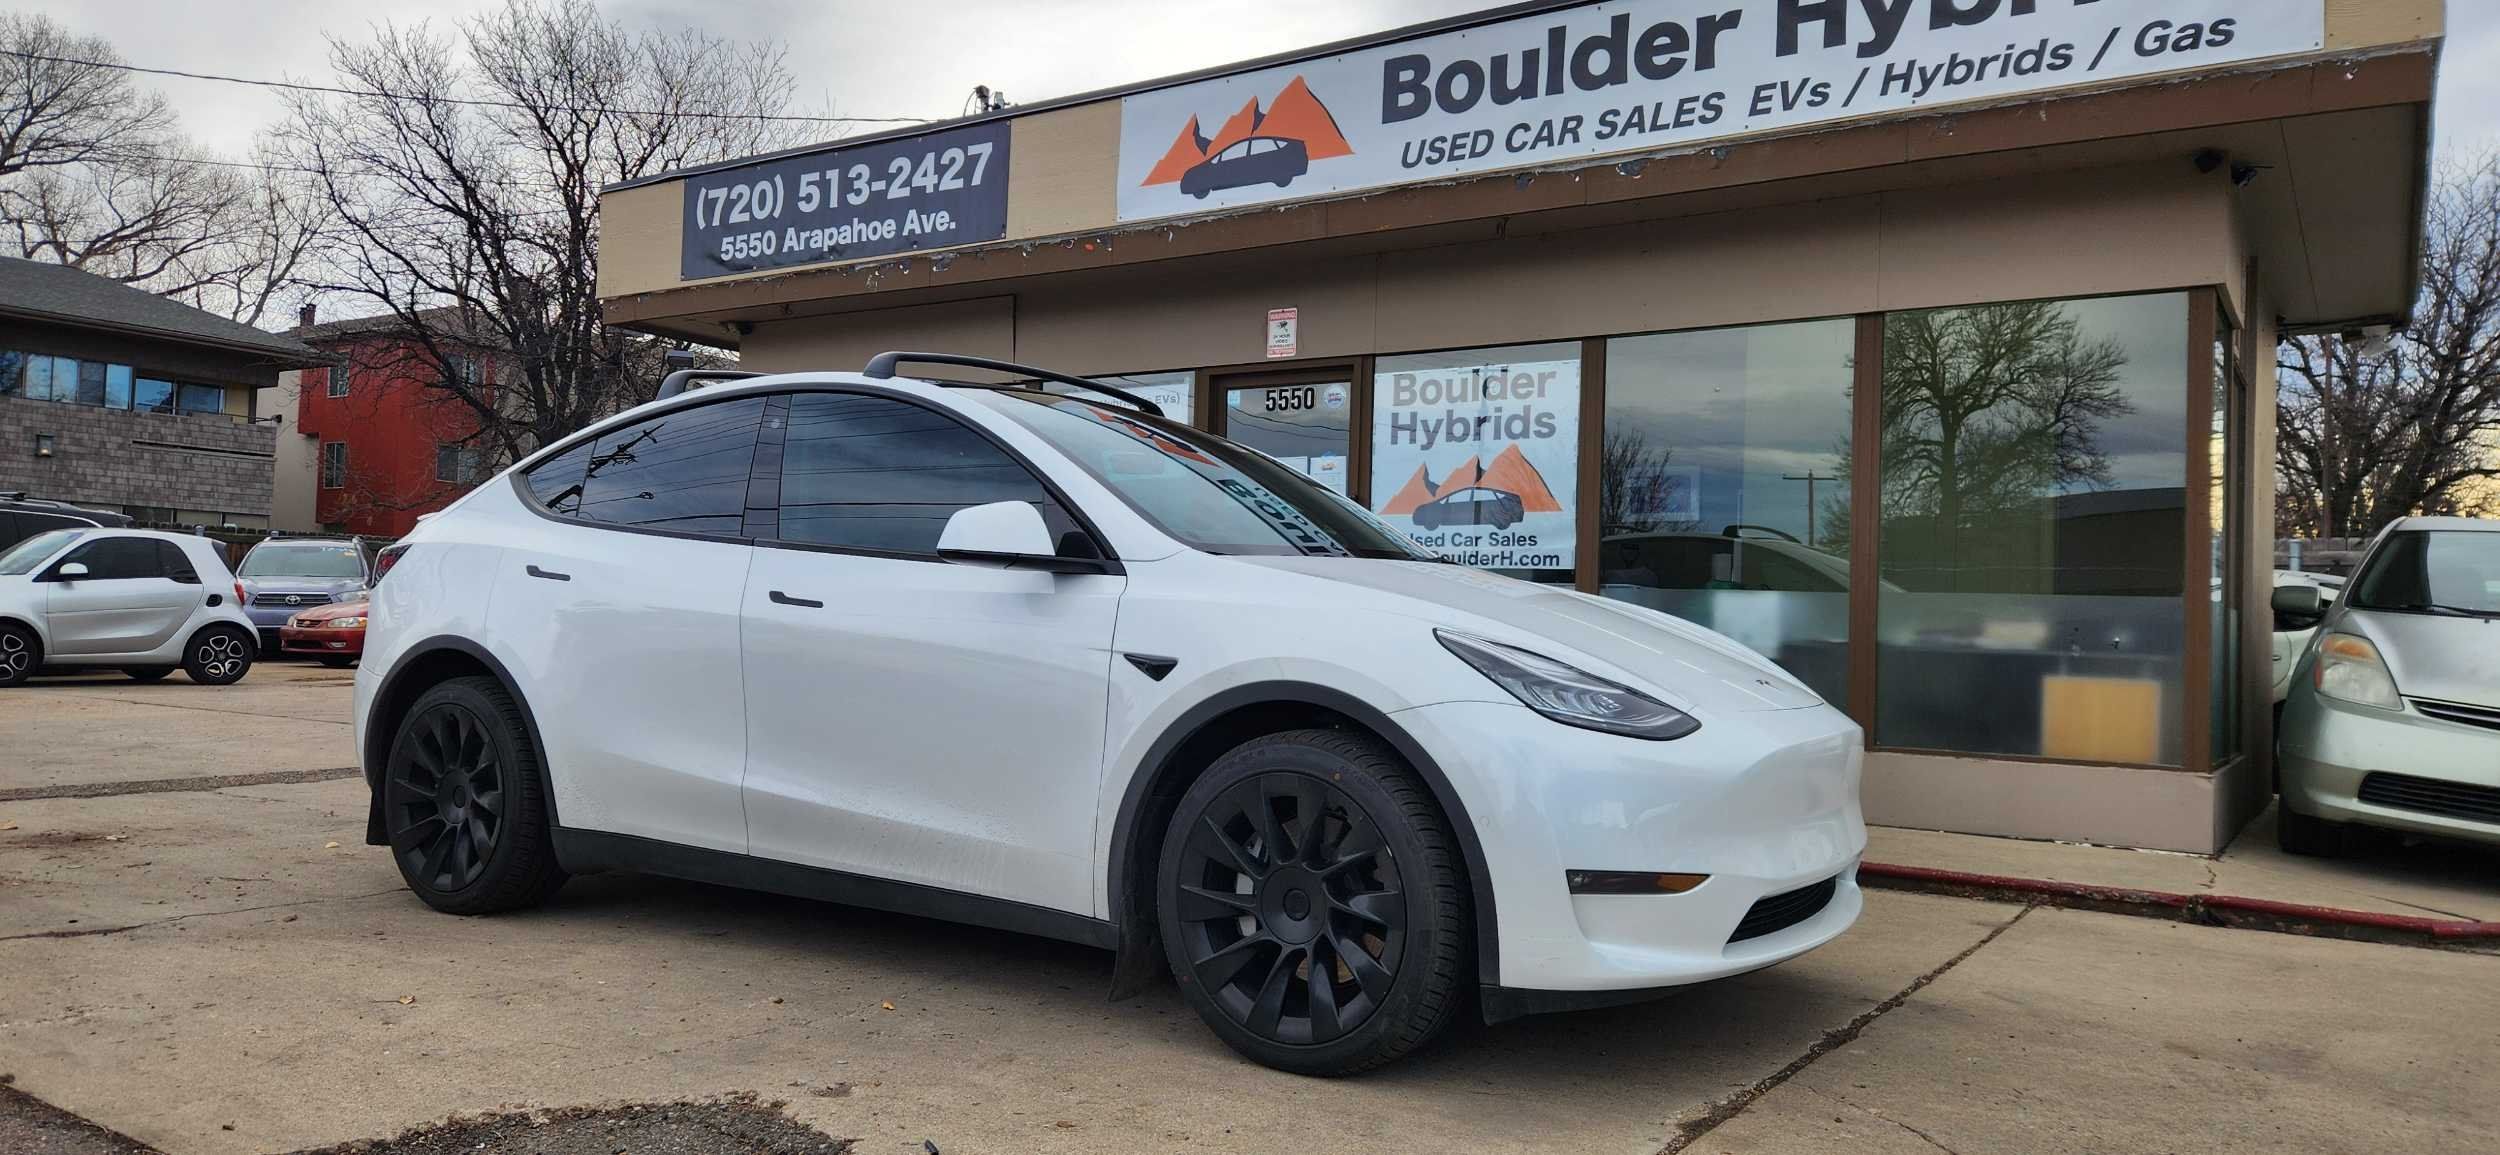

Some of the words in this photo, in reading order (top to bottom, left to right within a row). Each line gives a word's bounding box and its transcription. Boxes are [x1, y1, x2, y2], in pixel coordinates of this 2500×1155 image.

[1381, 9, 1743, 125] Boulder
[1401, 129, 1494, 169] USED
[1505, 115, 1584, 154] CAR
[1594, 91, 1726, 140] SALES
[1748, 77, 1832, 118] EVs
[1842, 67, 1869, 108] /
[1879, 39, 2074, 99] Hybrids
[2087, 27, 2121, 71] /
[2133, 18, 2237, 57] Gas
[696, 173, 785, 230] (720)
[797, 142, 993, 213] 513-2427
[720, 230, 776, 262] 5550
[782, 216, 897, 253] Arapahoe
[902, 208, 956, 237] Ave.
[1265, 387, 1315, 411] 5550
[1392, 370, 1557, 407] Boulder
[1390, 405, 1557, 451] Hybrids
[1451, 532, 1482, 547] Car
[1489, 532, 1538, 547] Sales
